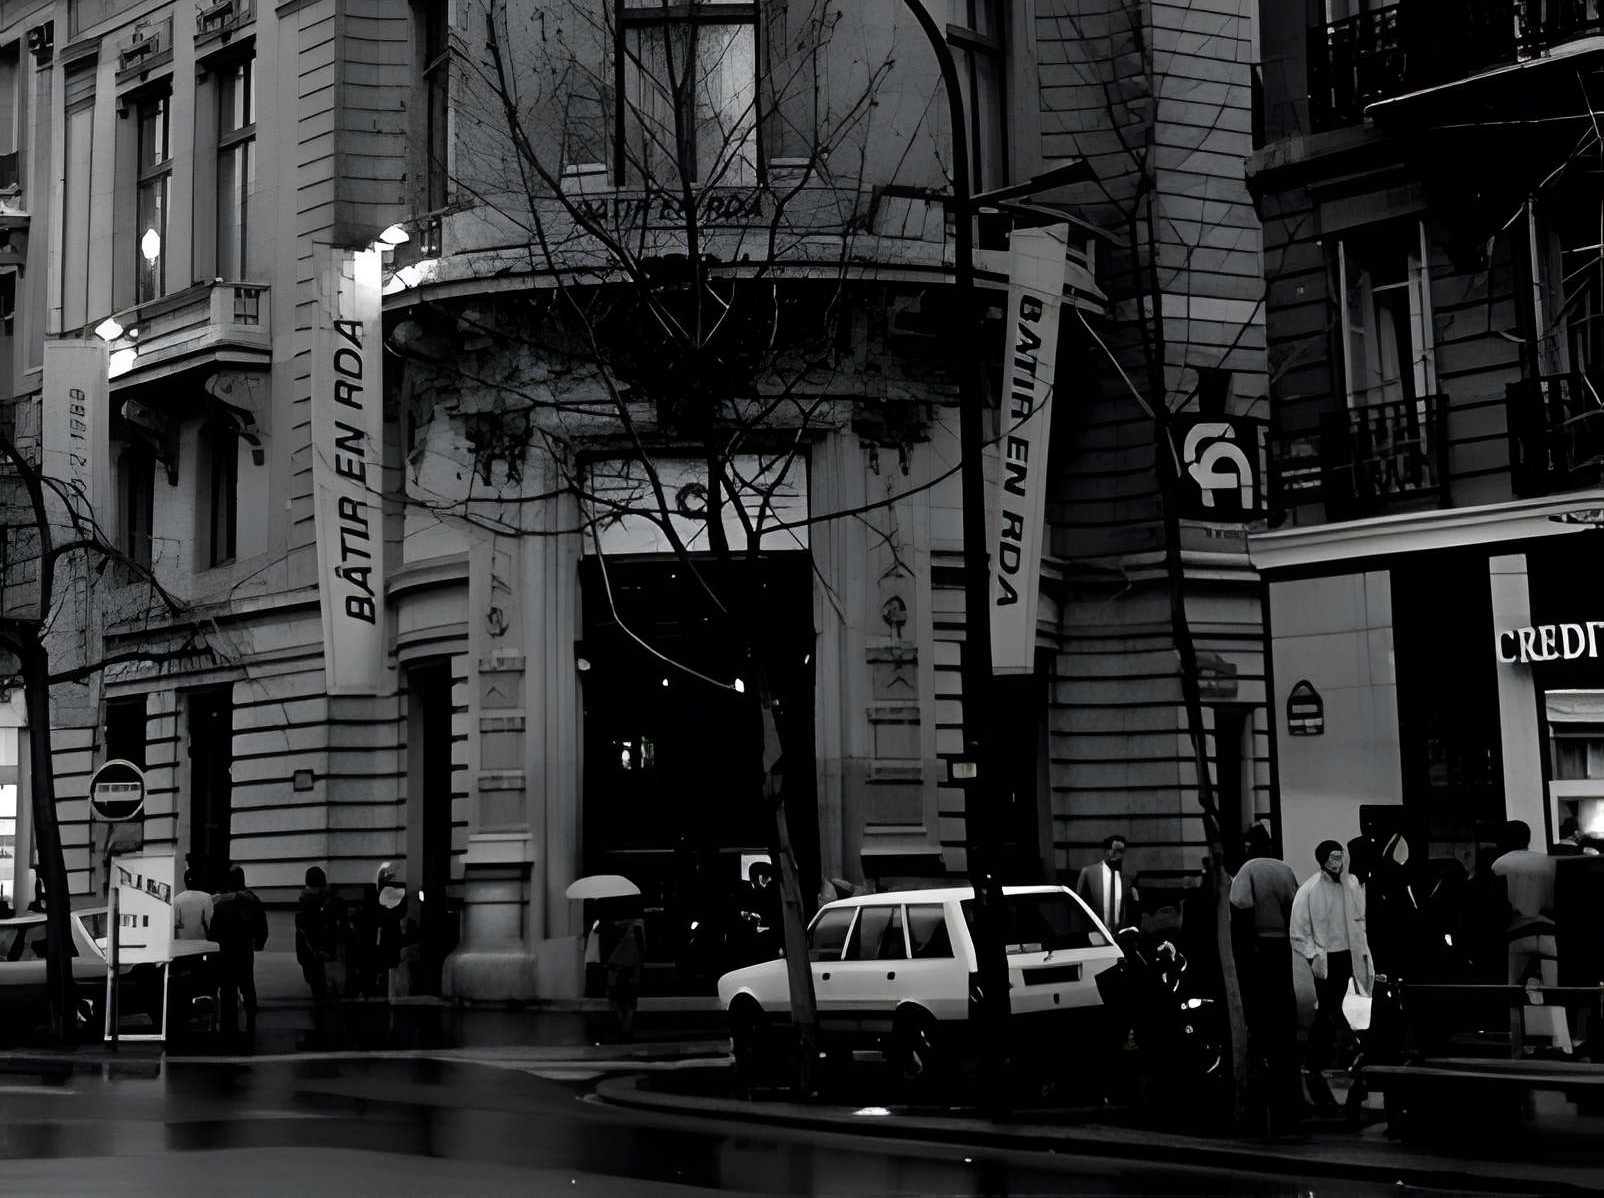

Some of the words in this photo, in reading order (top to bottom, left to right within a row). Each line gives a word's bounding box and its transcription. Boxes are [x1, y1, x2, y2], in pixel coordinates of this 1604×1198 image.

[333, 320, 364, 410] RDA
[334, 421, 366, 483] EN
[1004, 436, 1029, 497] EN
[335, 496, 376, 625] BÂTIR
[996, 510, 1024, 607] RDA
